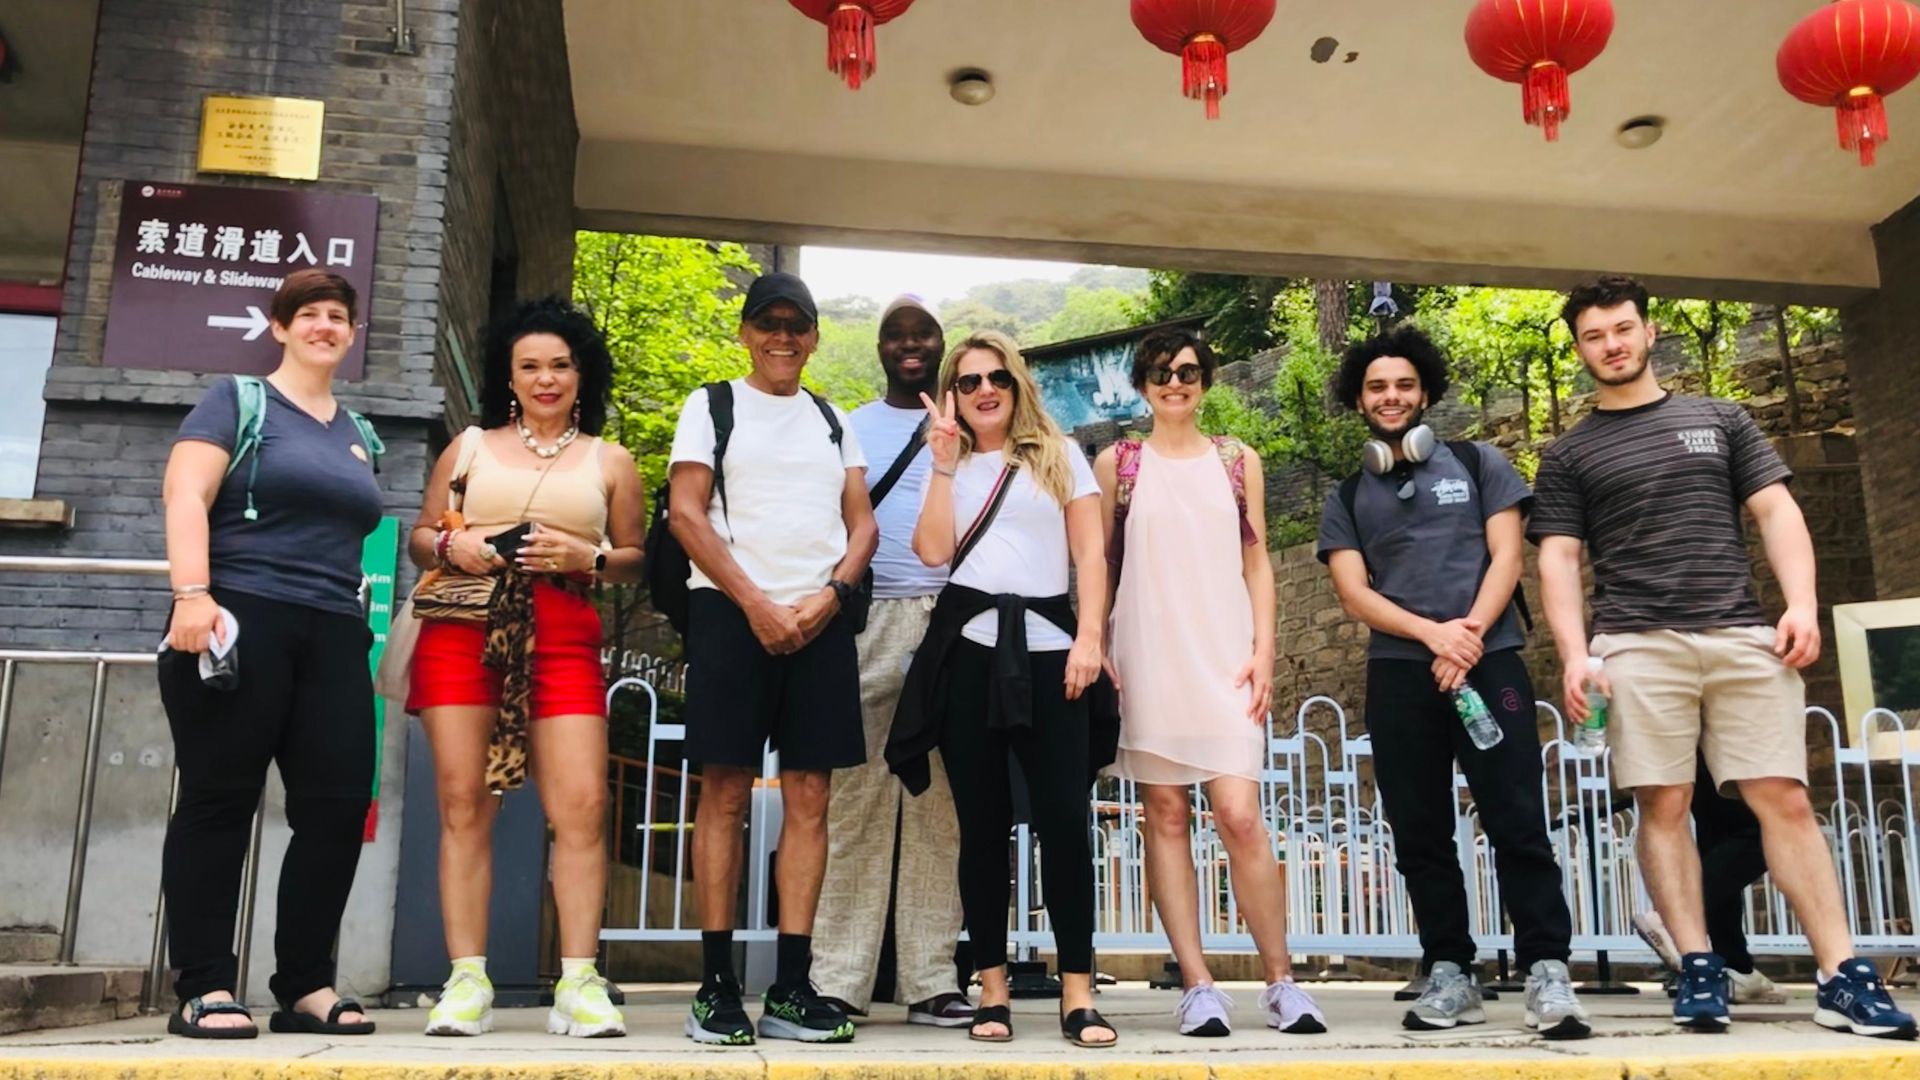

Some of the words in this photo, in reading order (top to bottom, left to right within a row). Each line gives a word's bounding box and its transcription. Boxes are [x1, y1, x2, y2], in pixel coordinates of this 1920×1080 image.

[136, 218, 355, 267] 索道滑道入口
[132, 262, 202, 285] Cableway
[203, 268, 217, 285] &
[219, 270, 284, 291] Slideway
